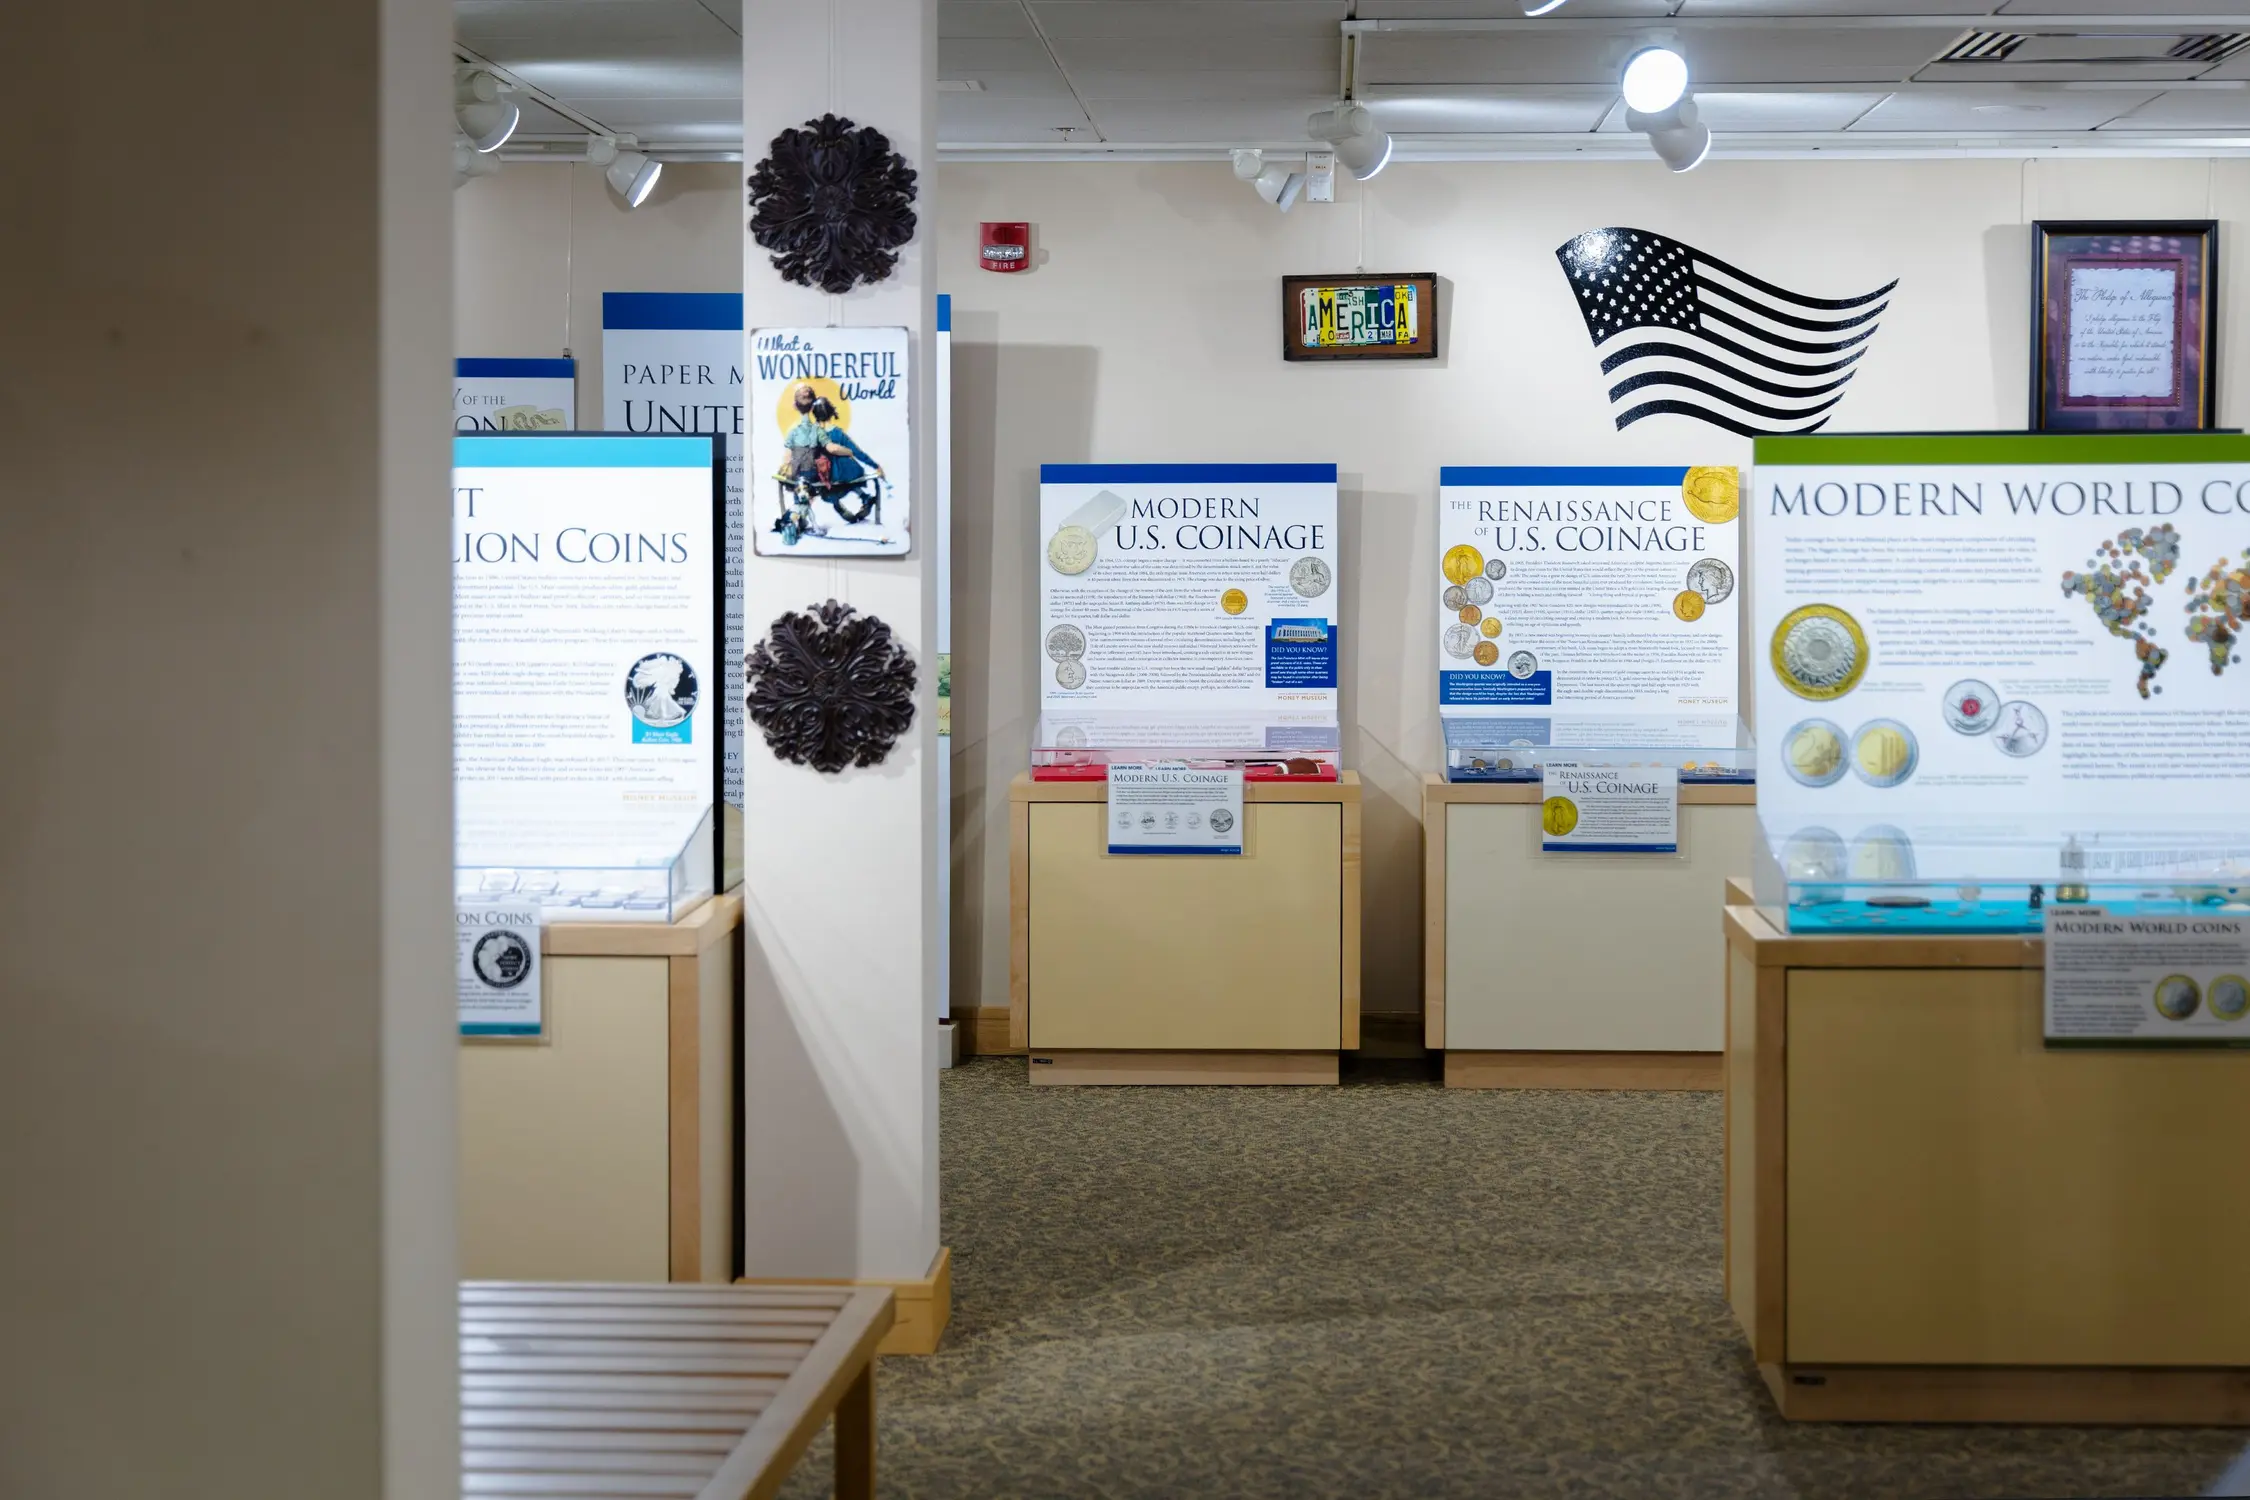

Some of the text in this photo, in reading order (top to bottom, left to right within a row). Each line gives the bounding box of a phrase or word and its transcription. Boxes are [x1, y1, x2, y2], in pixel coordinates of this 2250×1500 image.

[2119, 290, 2130, 306] of
[1308, 298, 1407, 340] AMERICA
[757, 334, 814, 352] What a
[622, 364, 715, 385] PAPER
[757, 351, 901, 380] WONDERFUL
[462, 395, 506, 405] OF THE
[840, 379, 896, 401] World
[1131, 497, 1260, 519] MODERN
[1770, 481, 1984, 517] MODERN
[2002, 480, 2183, 516] WORLD
[1450, 500, 1672, 522] THE RENAISSANCE
[556, 527, 688, 563] COINS
[1114, 524, 1325, 550] U.S. COINAGE
[1474, 525, 1706, 551] OF U.S. COINAGE
[1302, 646, 1328, 654] KNOW?
[1113, 774, 1229, 783] MODERN U.S. COINAGE
[1559, 771, 1619, 780] RENAISSANCE
[1568, 781, 1592, 794] U.S.
[1596, 781, 1659, 794] COINAGE
[485, 911, 533, 925] COINS
[2054, 922, 2241, 934] MODERN WORLD COINS
